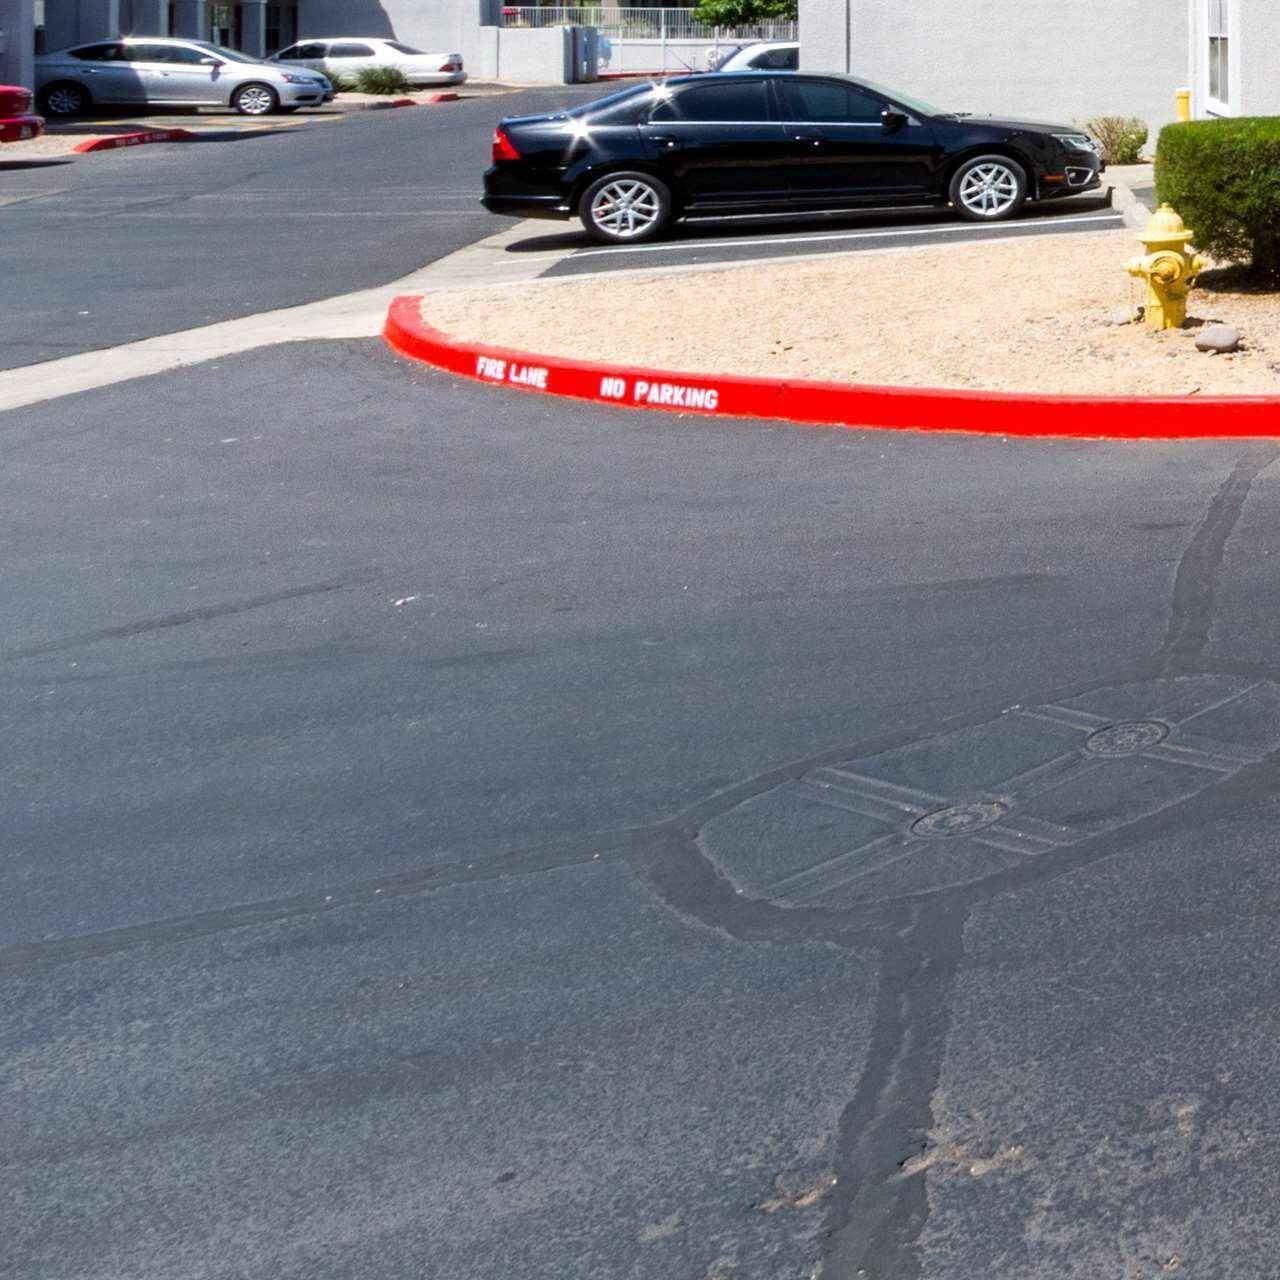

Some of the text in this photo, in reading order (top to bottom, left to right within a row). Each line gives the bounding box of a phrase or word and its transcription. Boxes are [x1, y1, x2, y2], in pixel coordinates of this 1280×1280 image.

[477, 357, 718, 409] FIRE LANE NO PARKING
